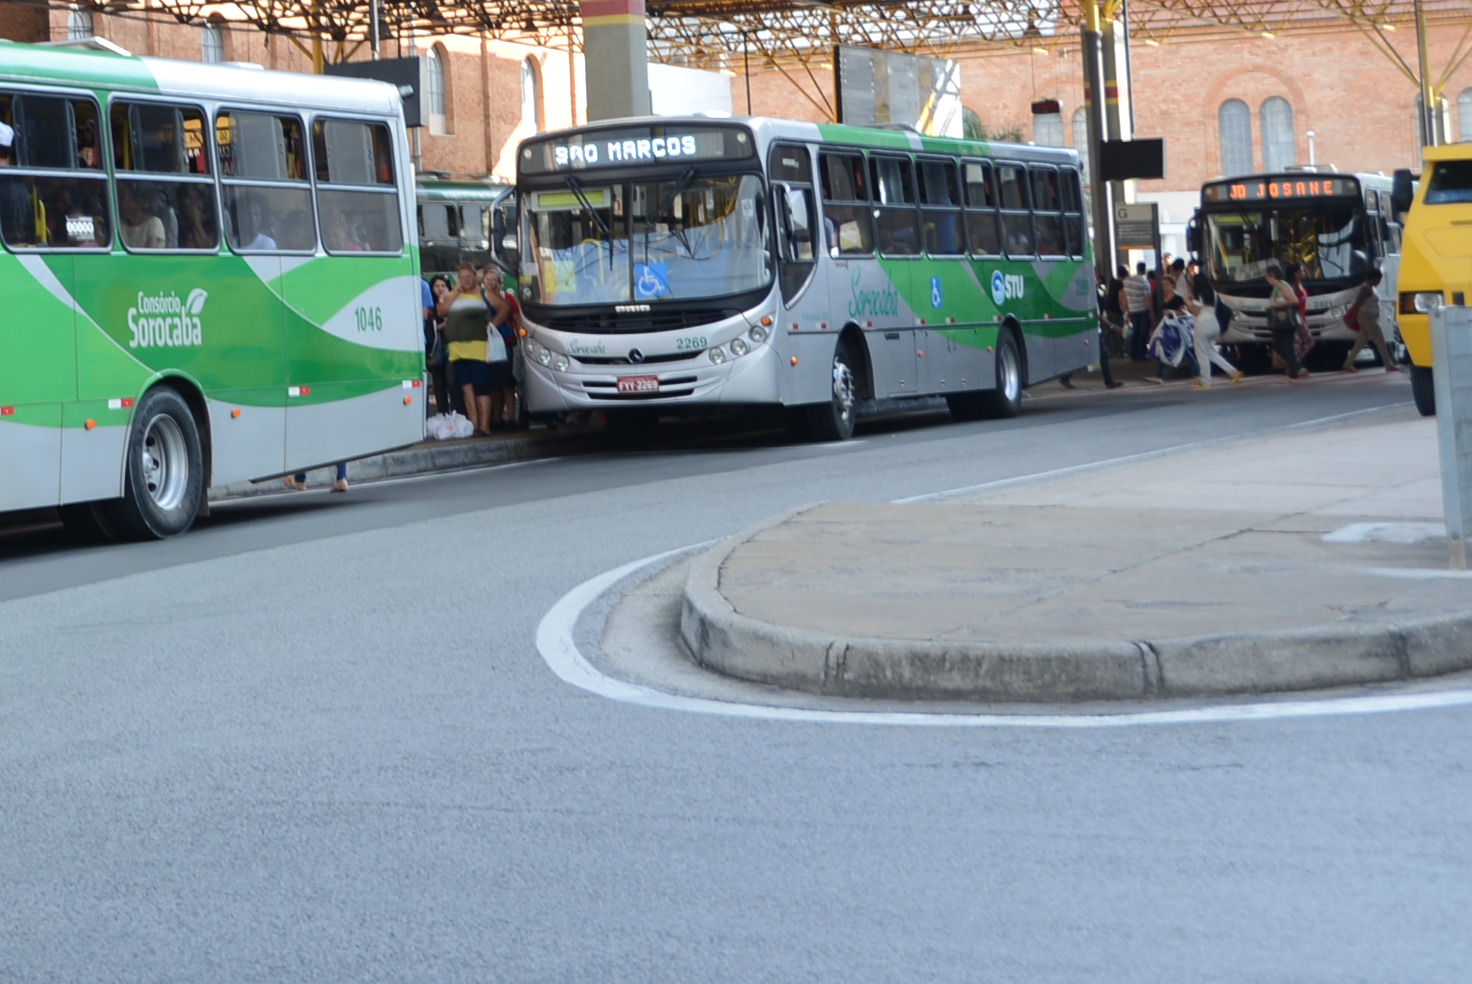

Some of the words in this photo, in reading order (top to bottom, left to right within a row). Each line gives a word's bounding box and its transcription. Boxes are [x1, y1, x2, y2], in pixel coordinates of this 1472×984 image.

[608, 136, 696, 162] MARCOS
[1257, 180, 1333, 199] JOSANE
[1005, 274, 1024, 299] STU
[137, 289, 181, 314] Consórcio
[128, 306, 202, 348] Sorocaba
[354, 306, 383, 332] 1046
[676, 336, 708, 350] 2269
